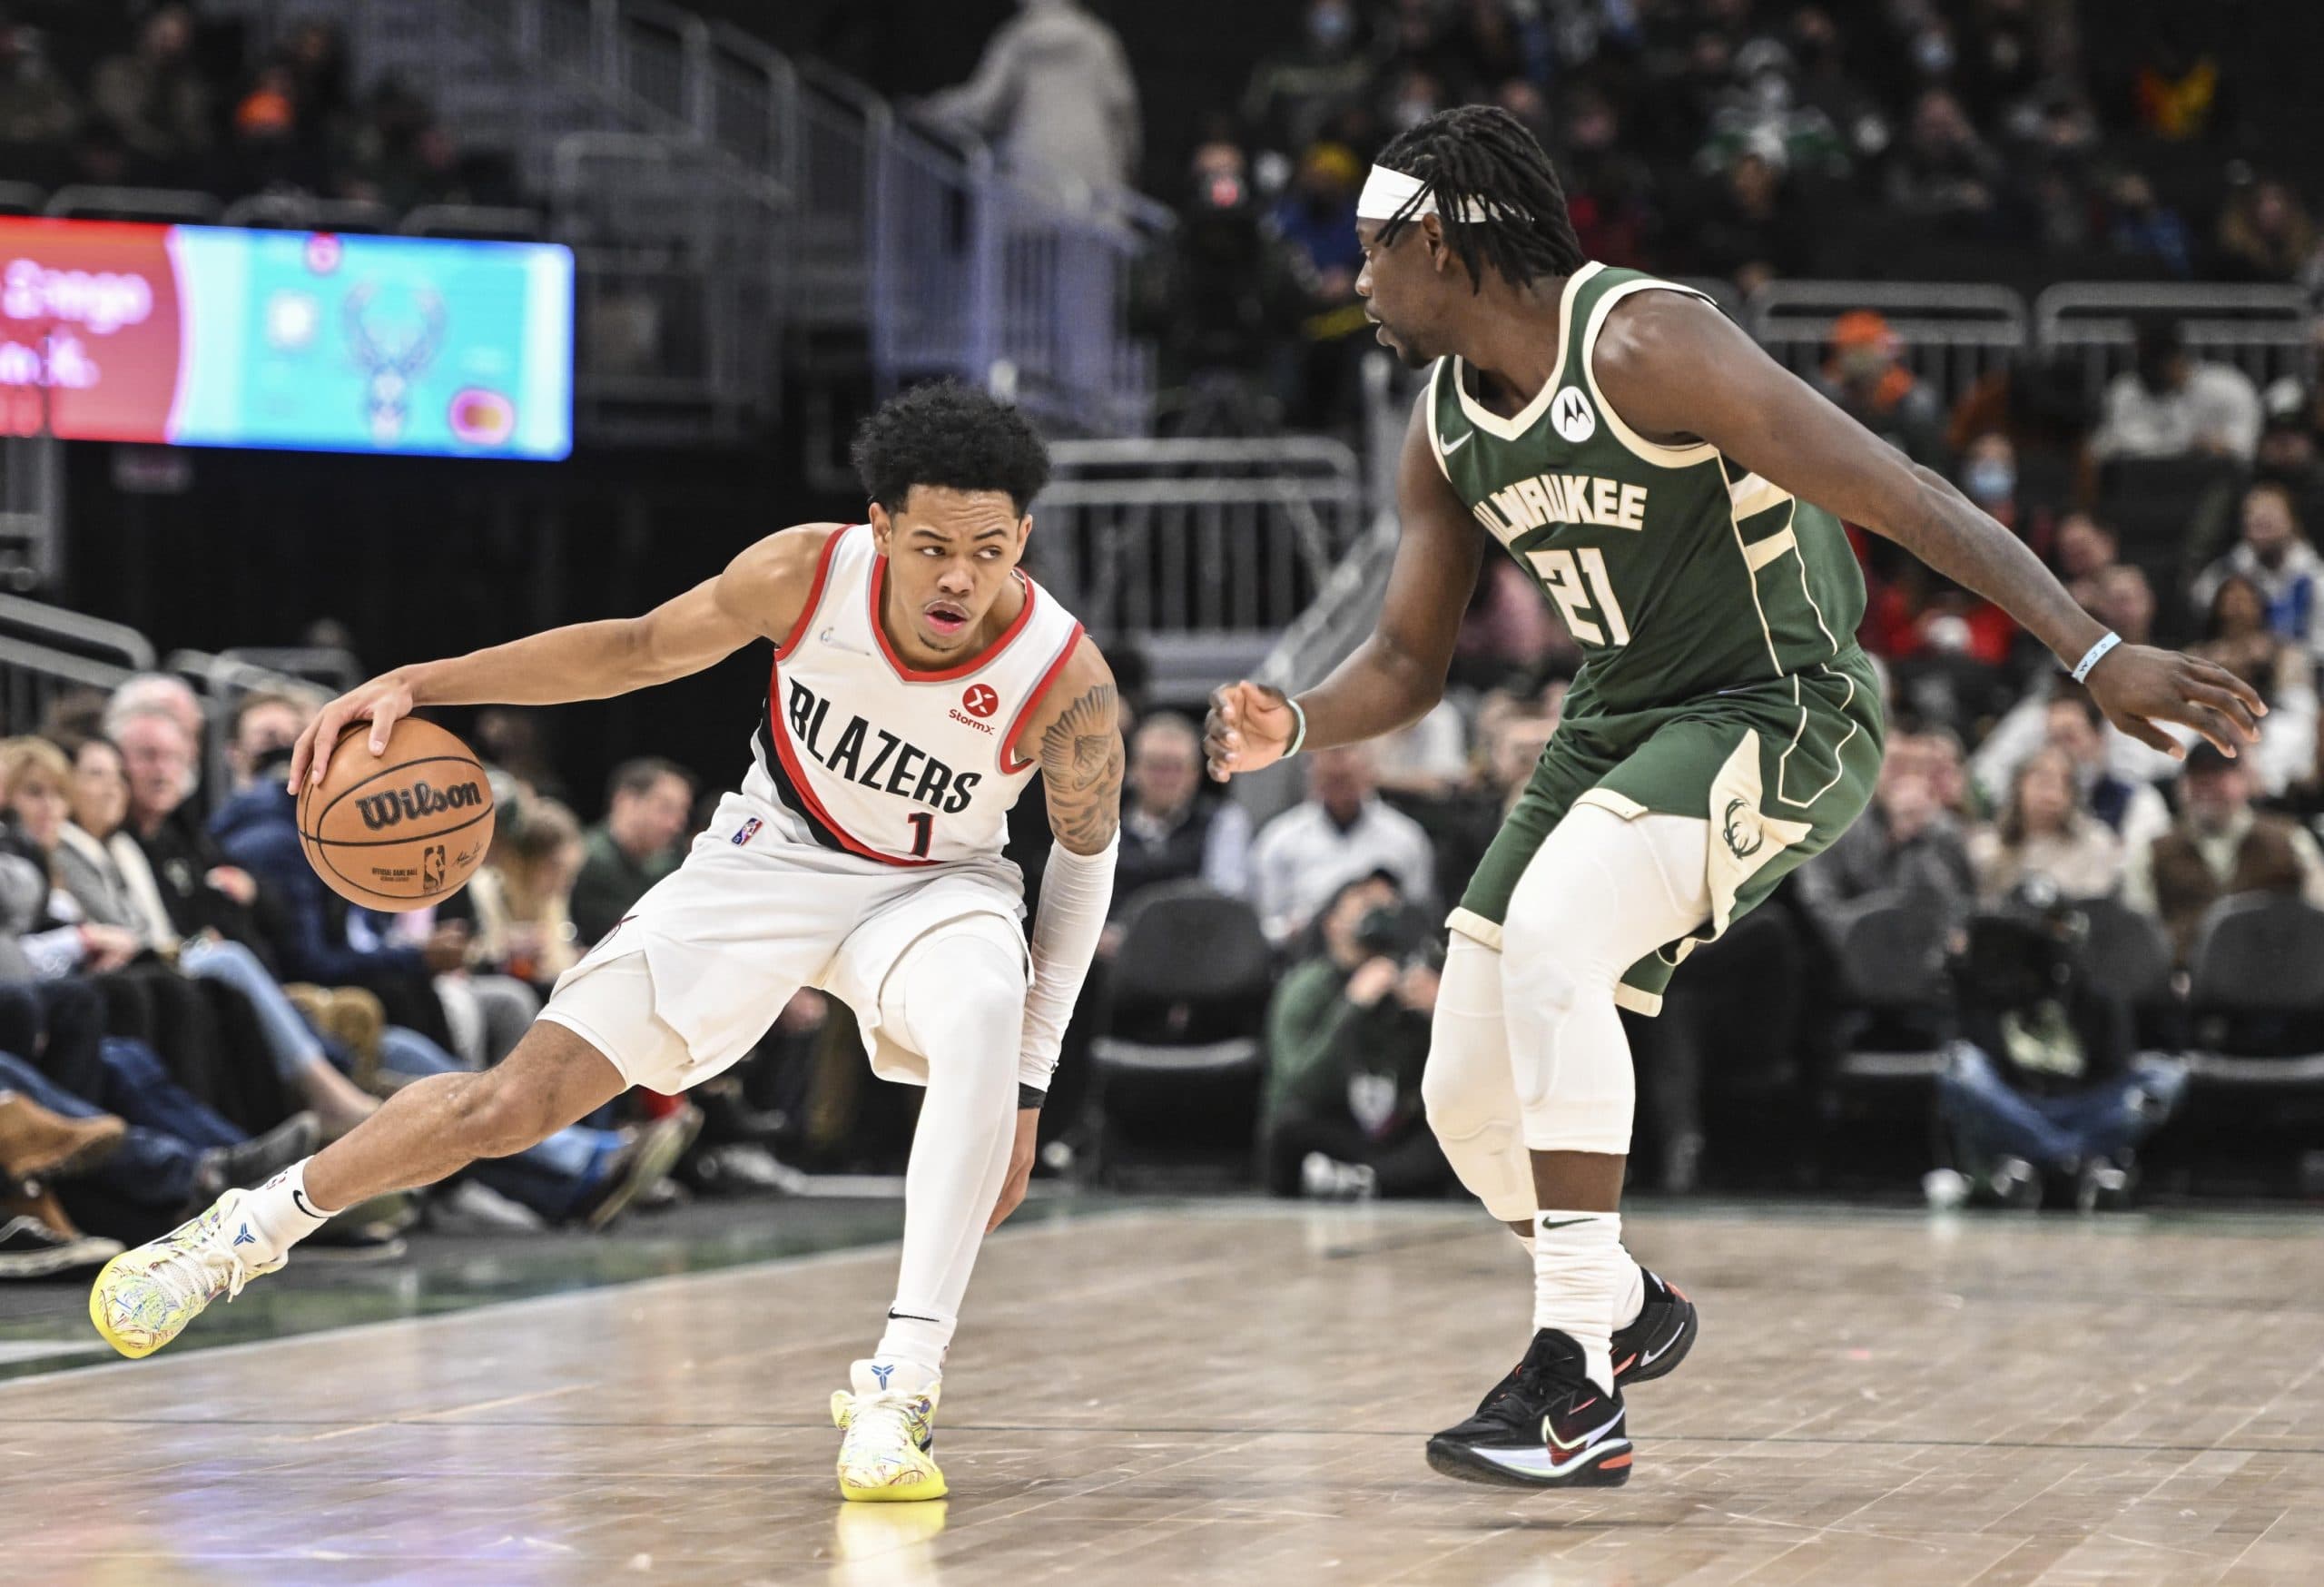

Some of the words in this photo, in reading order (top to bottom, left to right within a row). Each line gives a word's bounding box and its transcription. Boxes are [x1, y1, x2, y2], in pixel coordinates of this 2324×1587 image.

[1472, 474, 1648, 548] ILWAUKEE
[1525, 547, 1630, 646] 21
[789, 675, 982, 813] BLAZERS
[355, 781, 483, 831] Wilson
[908, 813, 934, 858] 1
